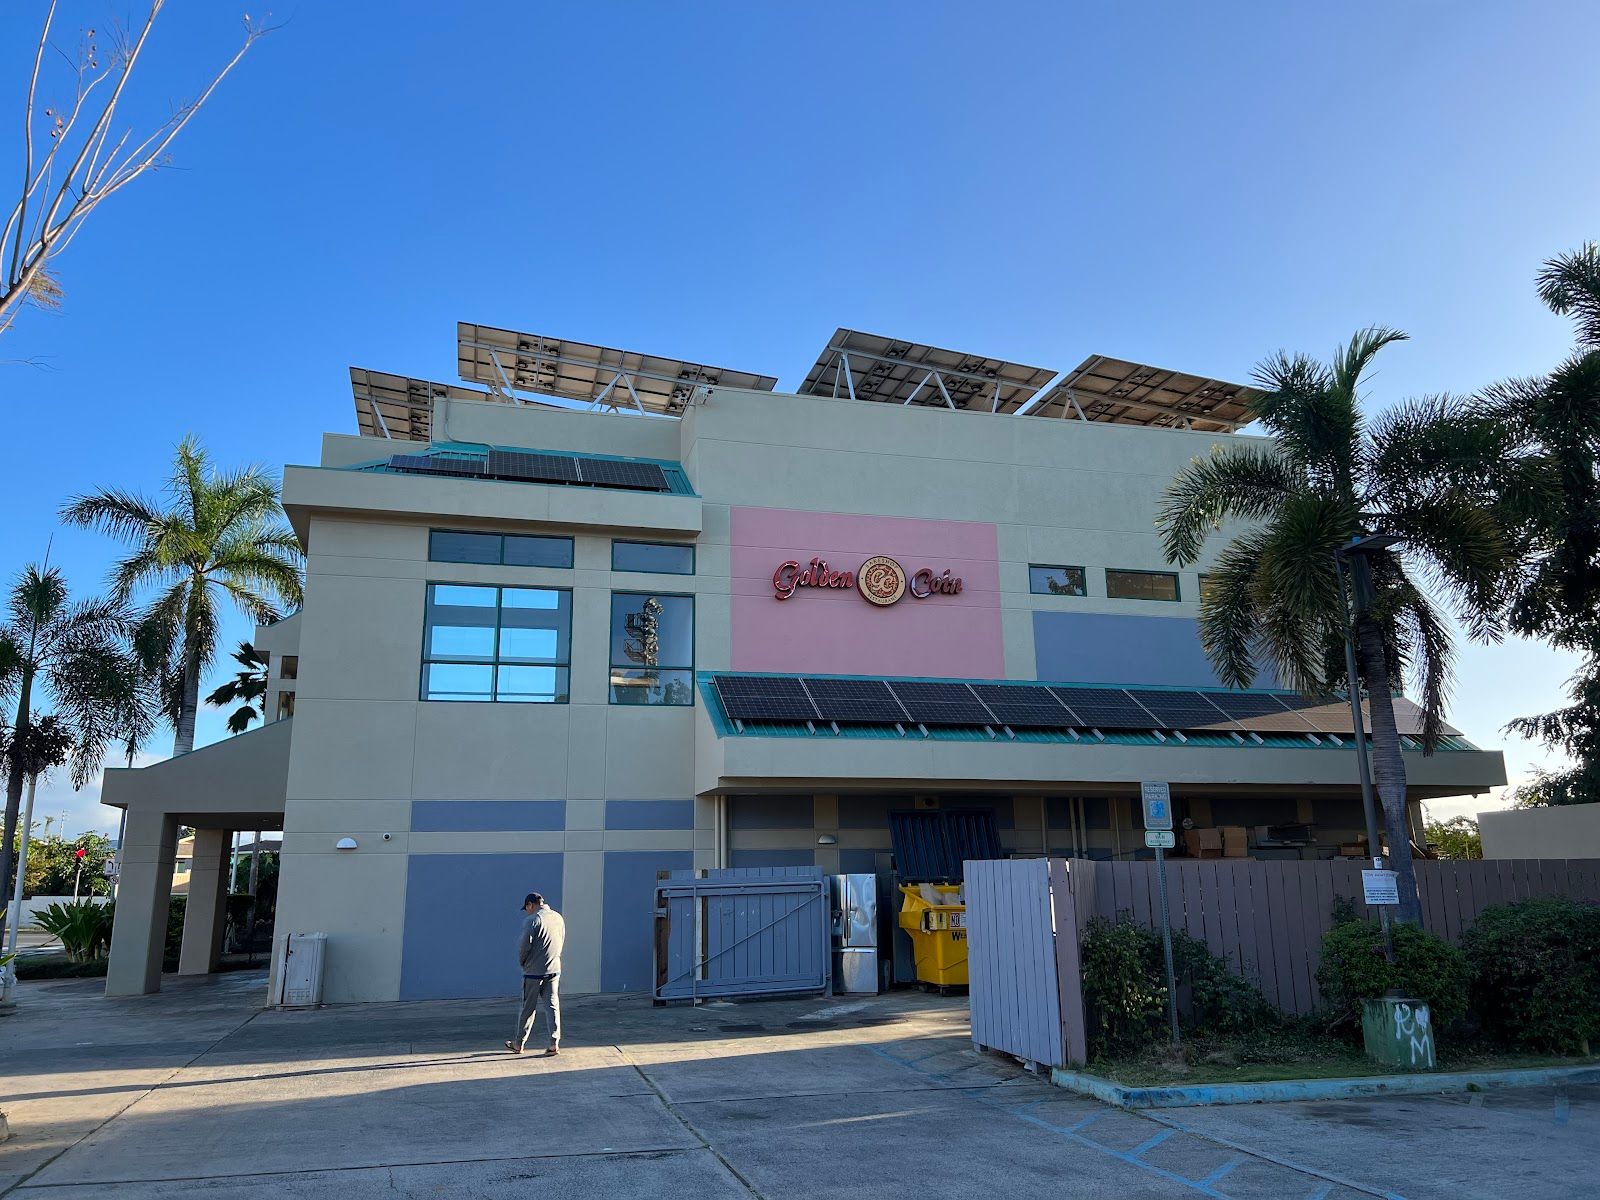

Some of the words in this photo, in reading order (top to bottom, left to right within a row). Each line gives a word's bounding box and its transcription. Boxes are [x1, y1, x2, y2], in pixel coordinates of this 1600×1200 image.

[773, 557, 853, 600] Golden
[909, 567, 963, 599] Coin
[867, 592, 898, 603] RESTAURANT
[1410, 1034, 1433, 1067] M
